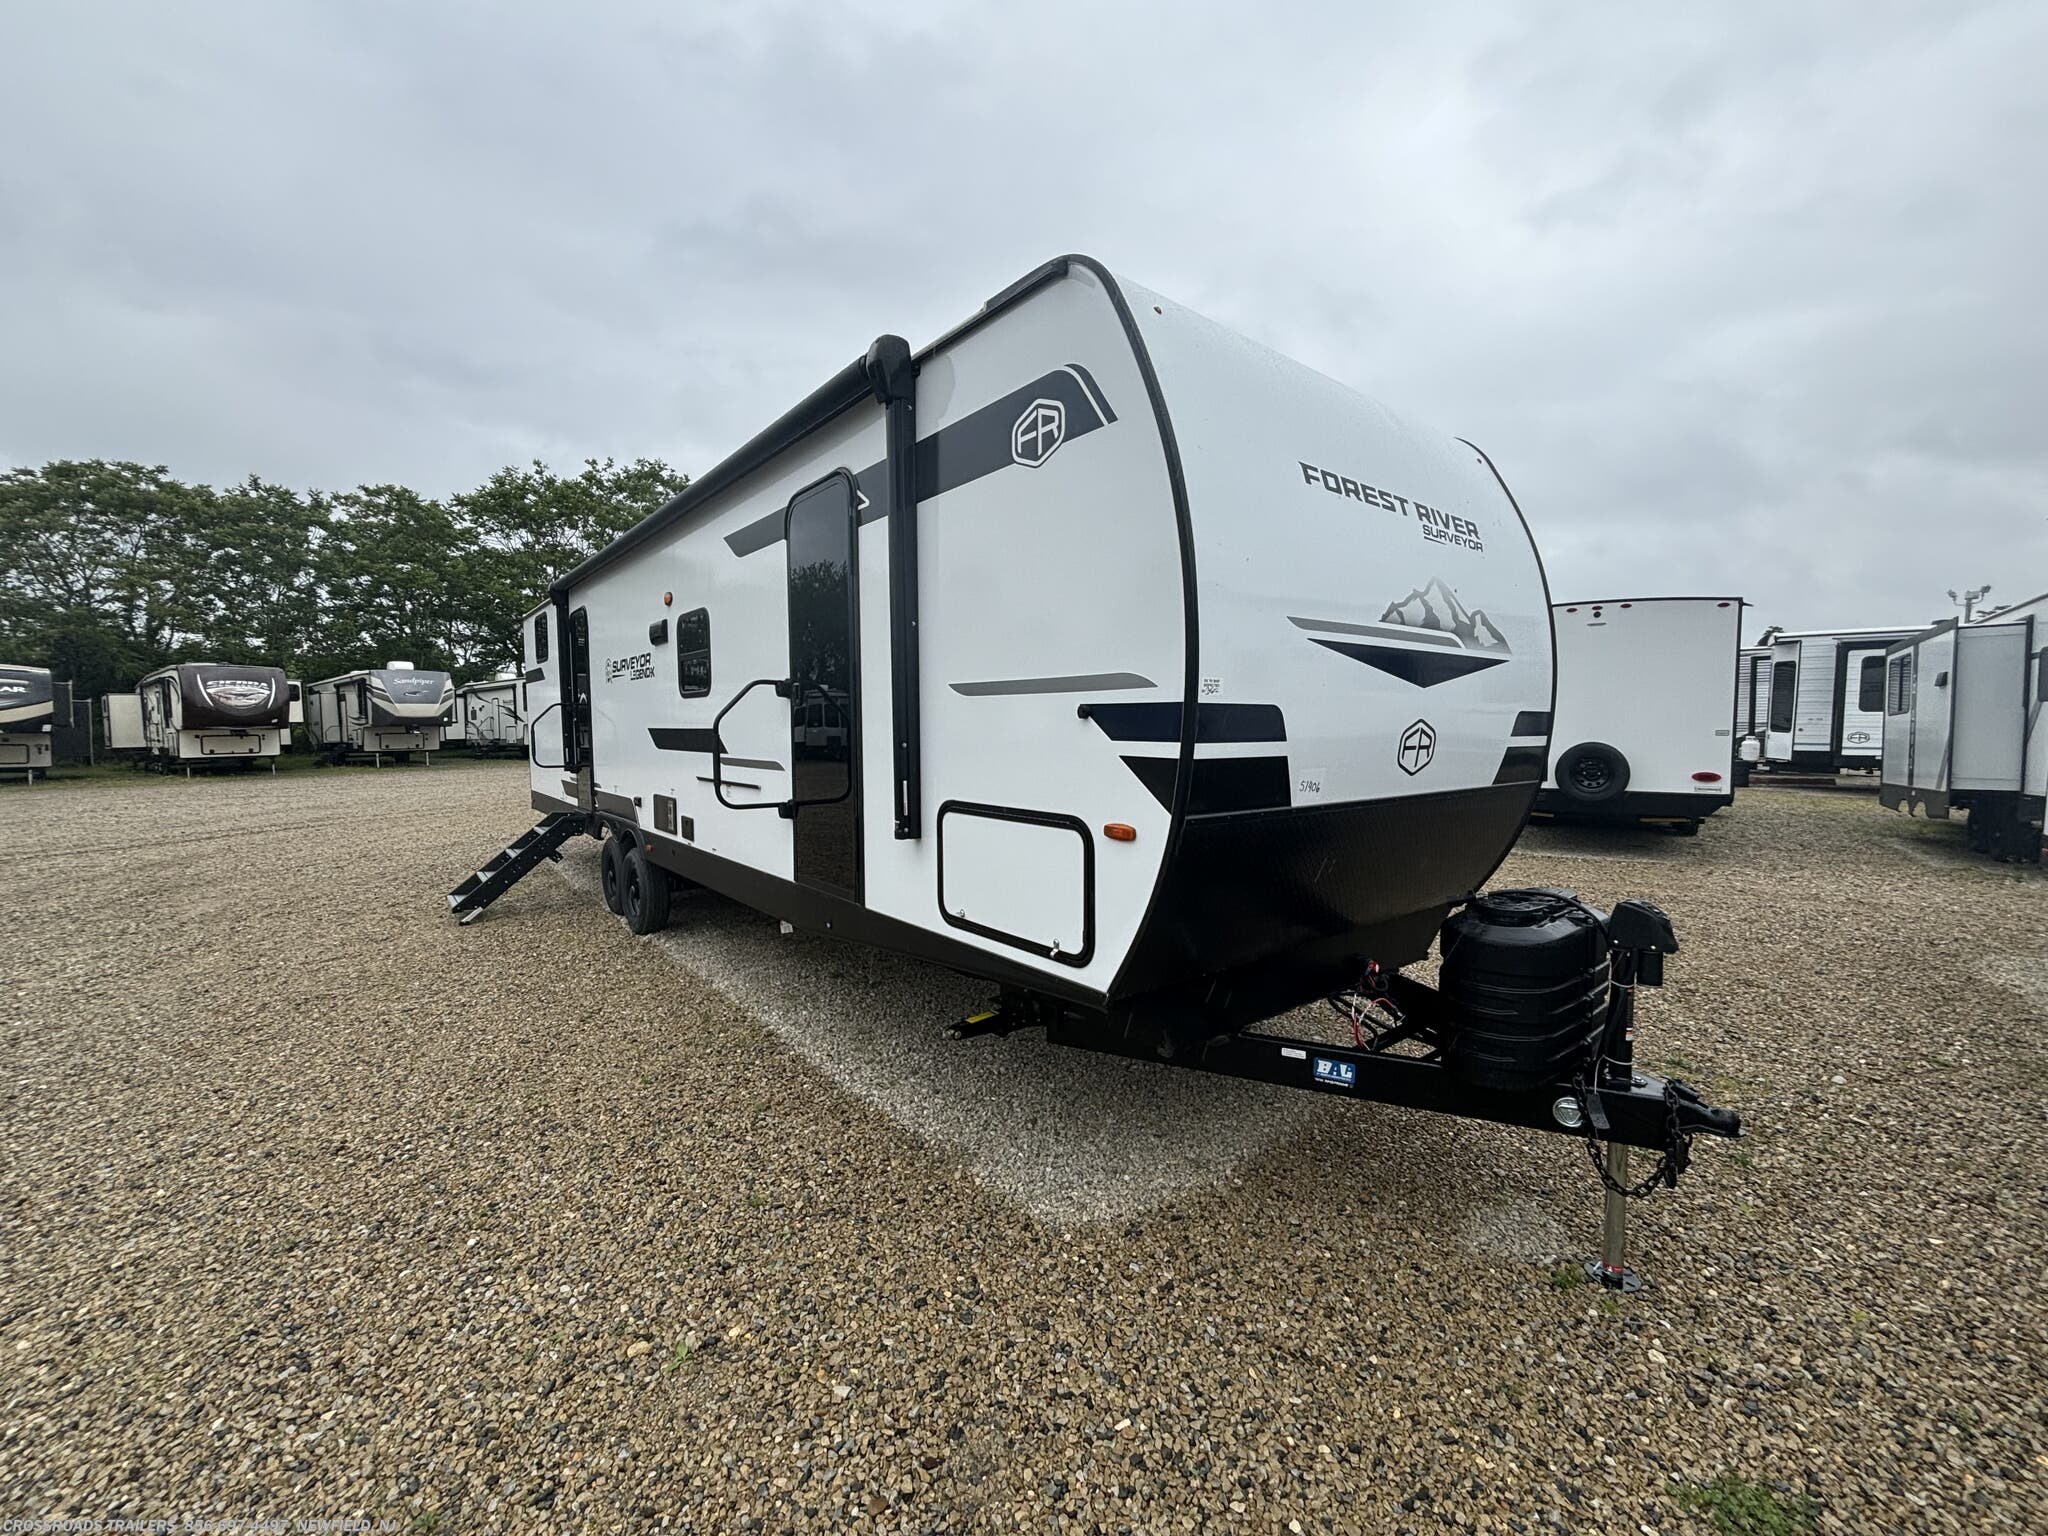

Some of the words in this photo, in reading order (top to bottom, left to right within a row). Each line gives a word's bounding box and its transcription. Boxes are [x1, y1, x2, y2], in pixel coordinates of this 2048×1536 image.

[1298, 461, 1409, 517] FOREST
[1413, 501, 1481, 540] RIVER
[1422, 524, 1484, 553] SURVEYOR
[612, 652, 652, 673] SURVEYOR
[393, 676, 435, 686] Sandpiper
